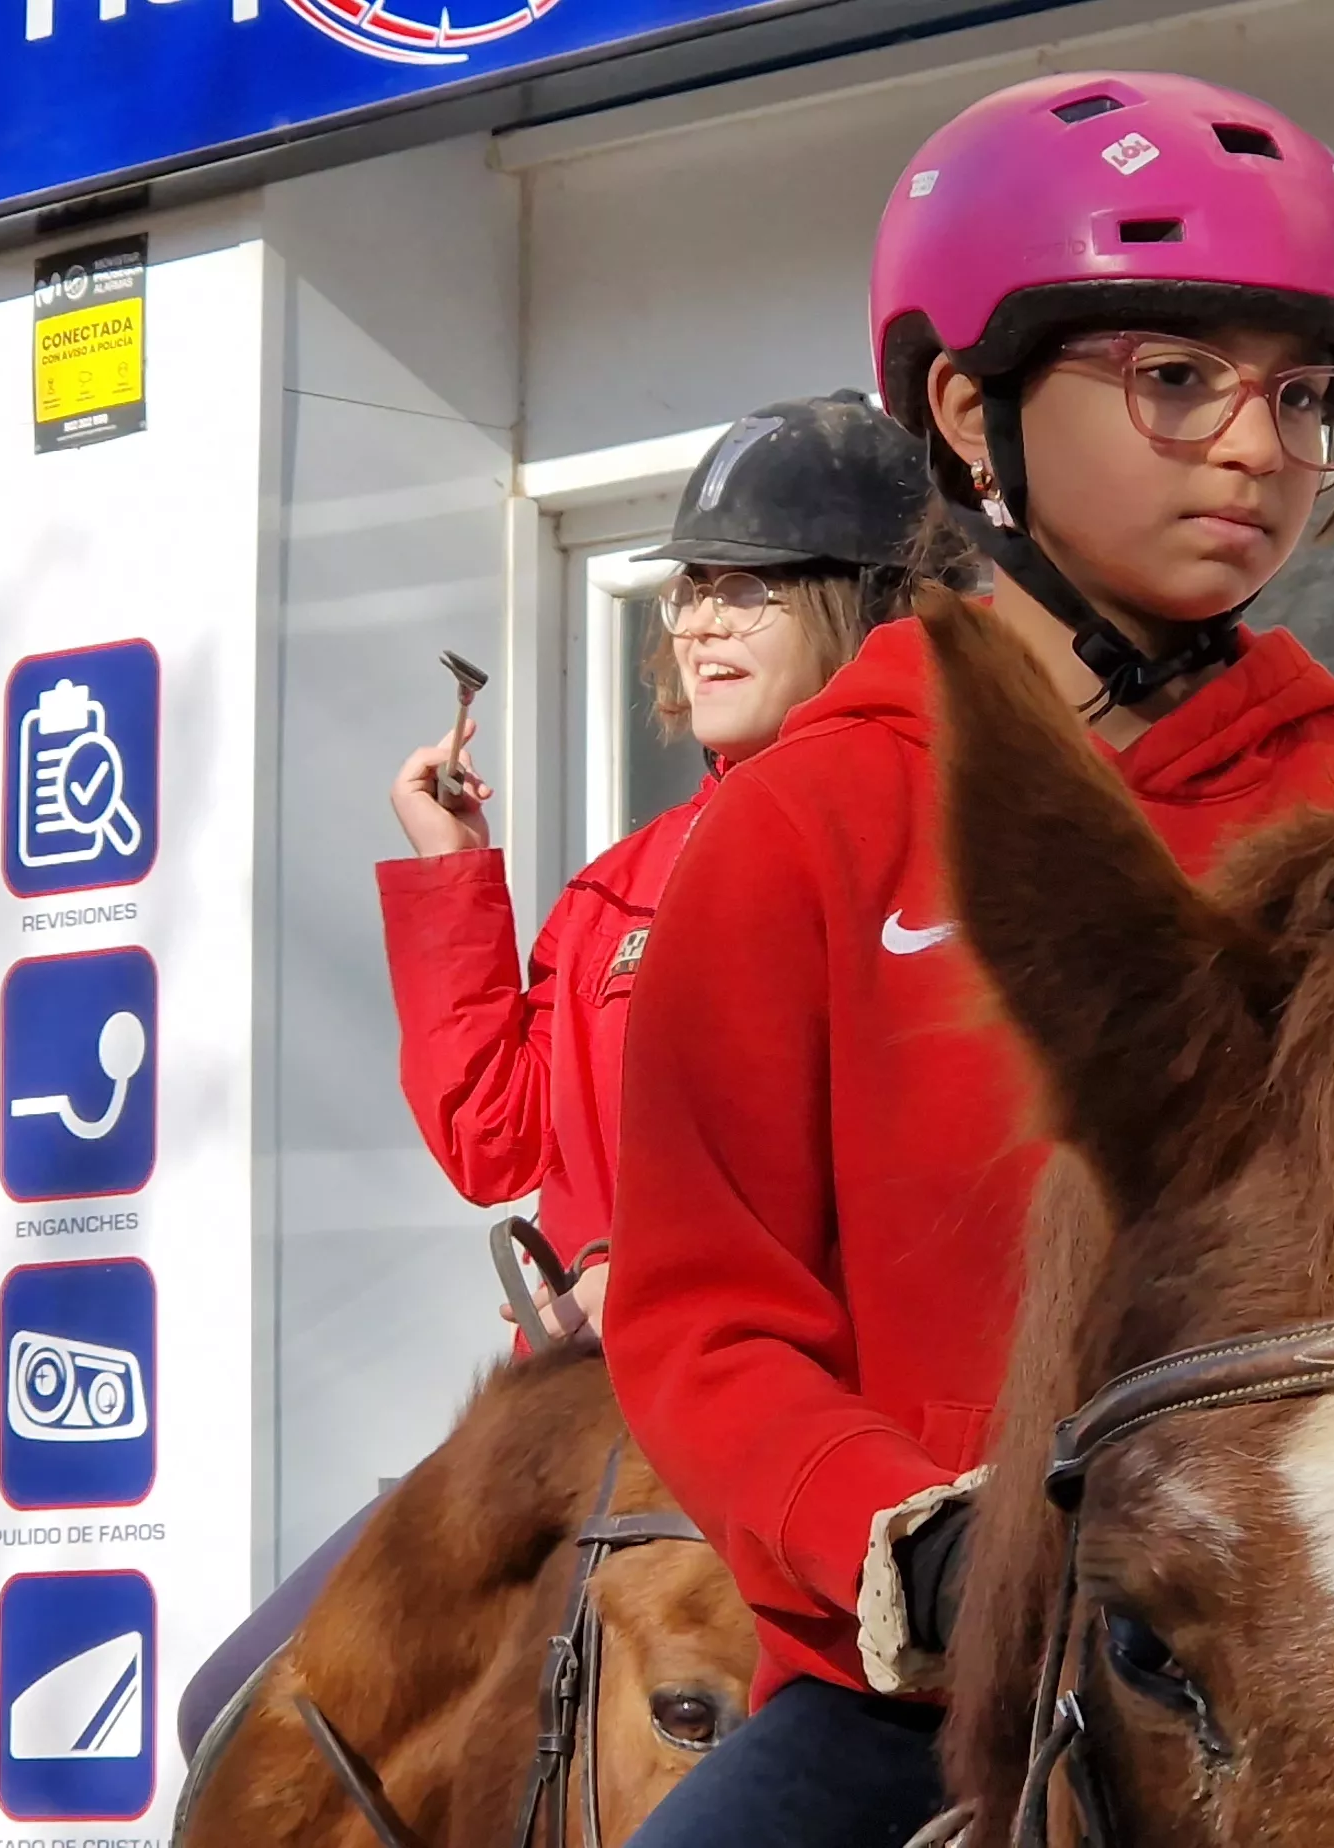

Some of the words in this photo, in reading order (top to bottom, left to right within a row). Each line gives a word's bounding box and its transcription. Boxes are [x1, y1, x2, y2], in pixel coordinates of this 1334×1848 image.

[1111, 140, 1152, 168] LOL
[42, 316, 134, 351] CONECTADA
[42, 352, 61, 365] CON
[62, 346, 87, 361] AVISO
[90, 343, 96, 353] A
[98, 335, 134, 352] POLICÍA
[22, 902, 138, 932] REVISIONES
[16, 1212, 139, 1238] ENGANCHES
[67, 1525, 93, 1544] DE
[99, 1523, 165, 1543] FAROS
